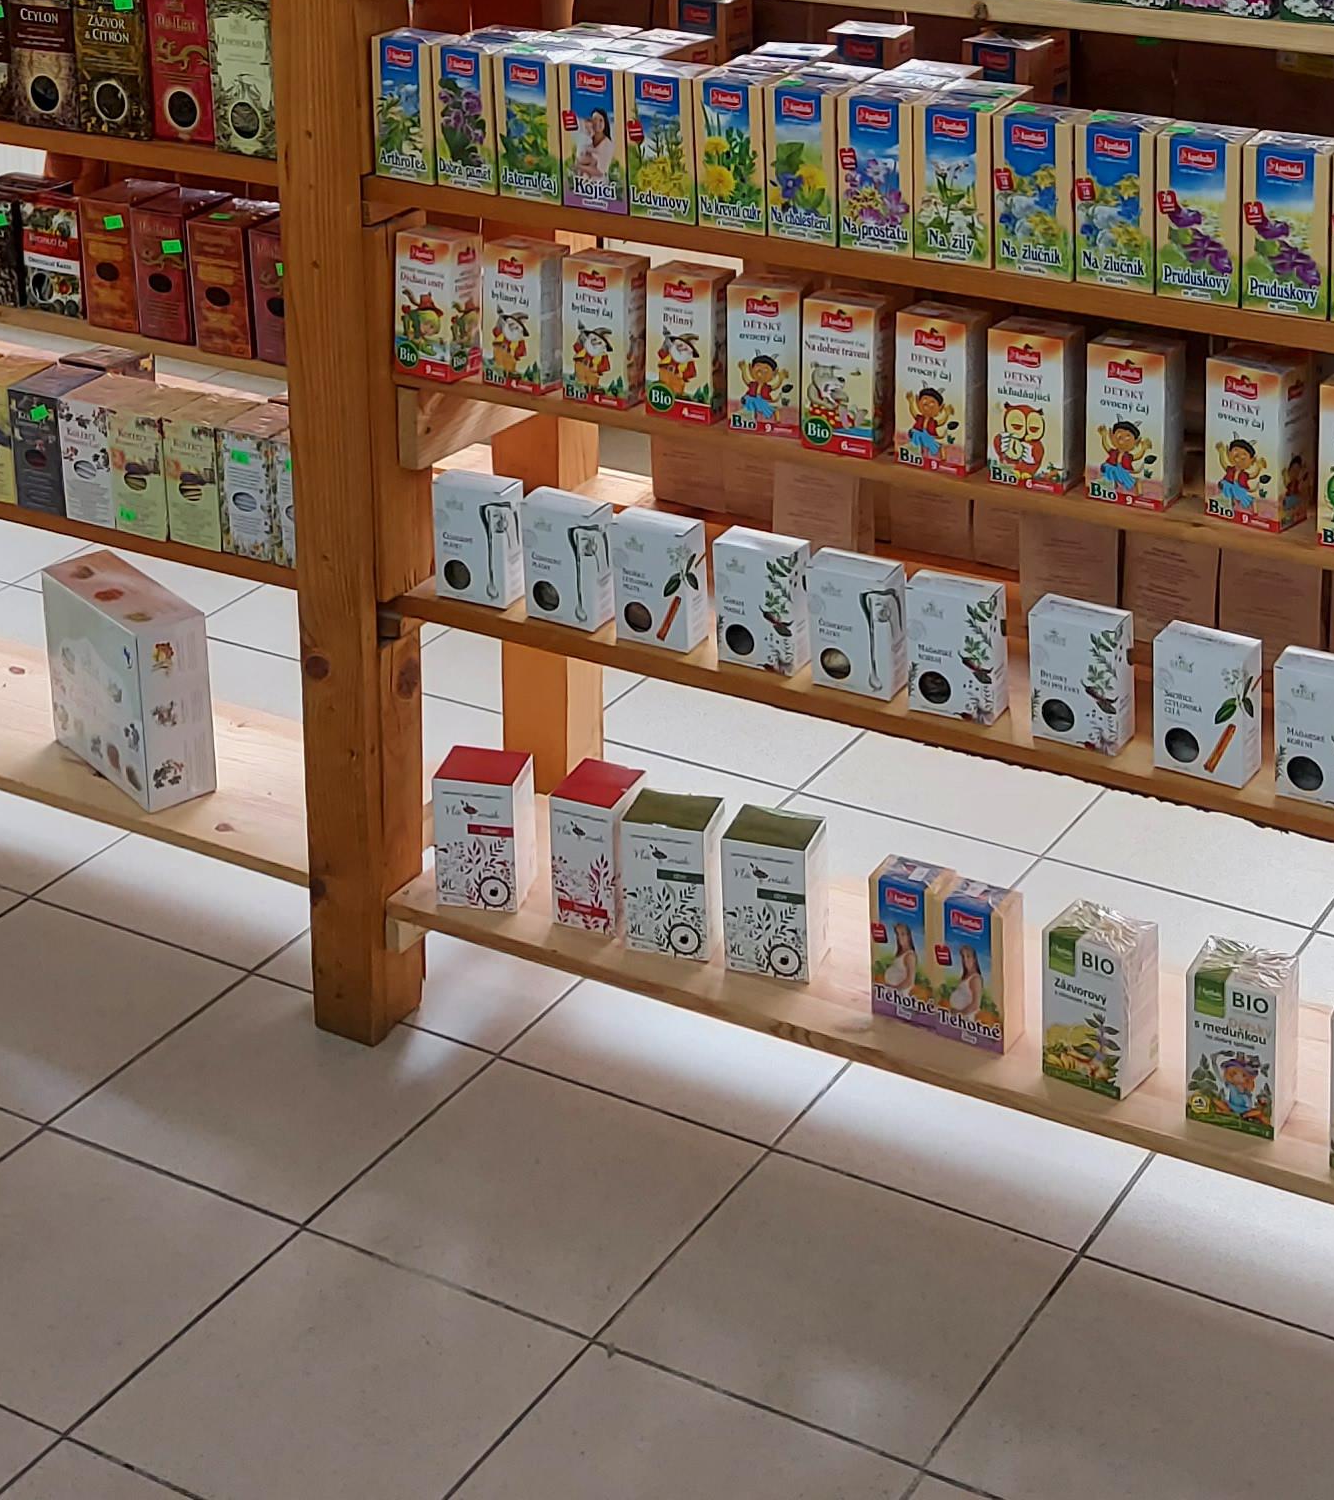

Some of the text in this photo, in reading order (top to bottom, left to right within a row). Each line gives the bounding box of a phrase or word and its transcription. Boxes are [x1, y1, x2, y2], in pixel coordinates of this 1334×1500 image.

[541, 176, 556, 193] čaj
[575, 176, 616, 200] Kojící
[842, 217, 908, 243] Na prostatu
[928, 229, 974, 253] Na žíly
[1001, 239, 1061, 266] Na žlučník
